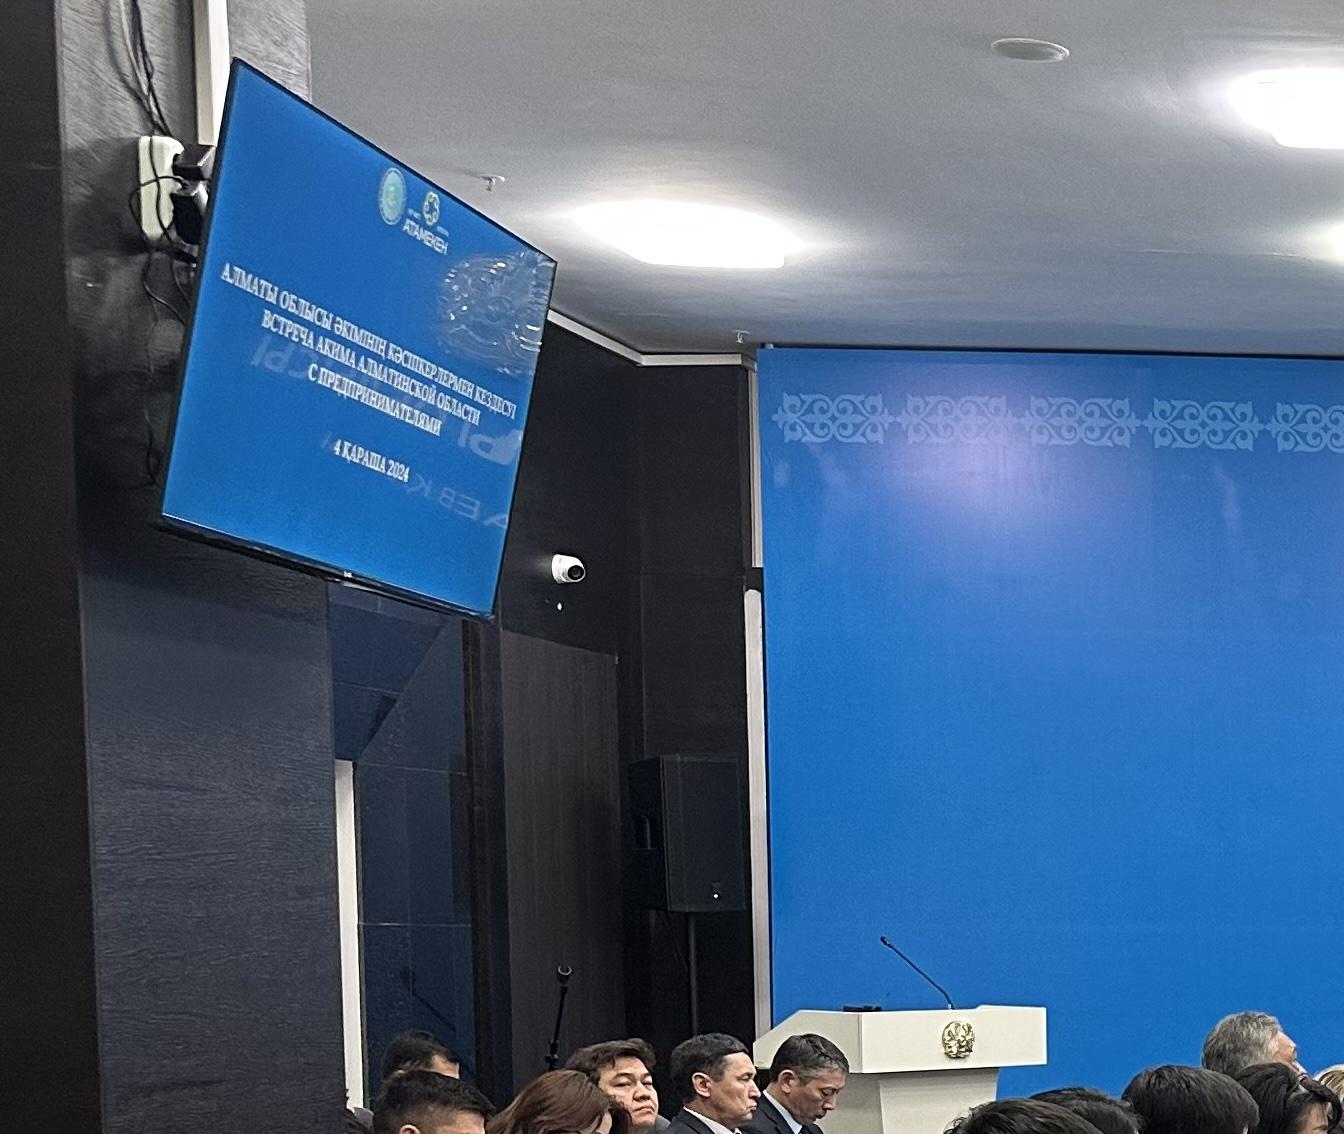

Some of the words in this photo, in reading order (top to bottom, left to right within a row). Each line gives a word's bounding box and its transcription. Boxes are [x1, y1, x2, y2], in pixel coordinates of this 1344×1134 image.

[402, 219, 449, 255] АТАМЕКЕН
[220, 262, 279, 304] АЛМАТЫ
[280, 290, 333, 331] ОБЛЫСЫ
[261, 309, 314, 349] ВСТРЕЧА
[316, 336, 356, 369] АКИМА
[357, 355, 437, 405] АЛМАТИНСКОЙ
[437, 392, 481, 426] ОБЛАСТИ
[308, 363, 319, 381] С
[318, 367, 443, 436] ПРЕДПРИНИМАТЕЛЯМИ
[333, 439, 342, 455] 4
[341, 440, 386, 473] ҚАРАША
[386, 458, 411, 483] 2024
